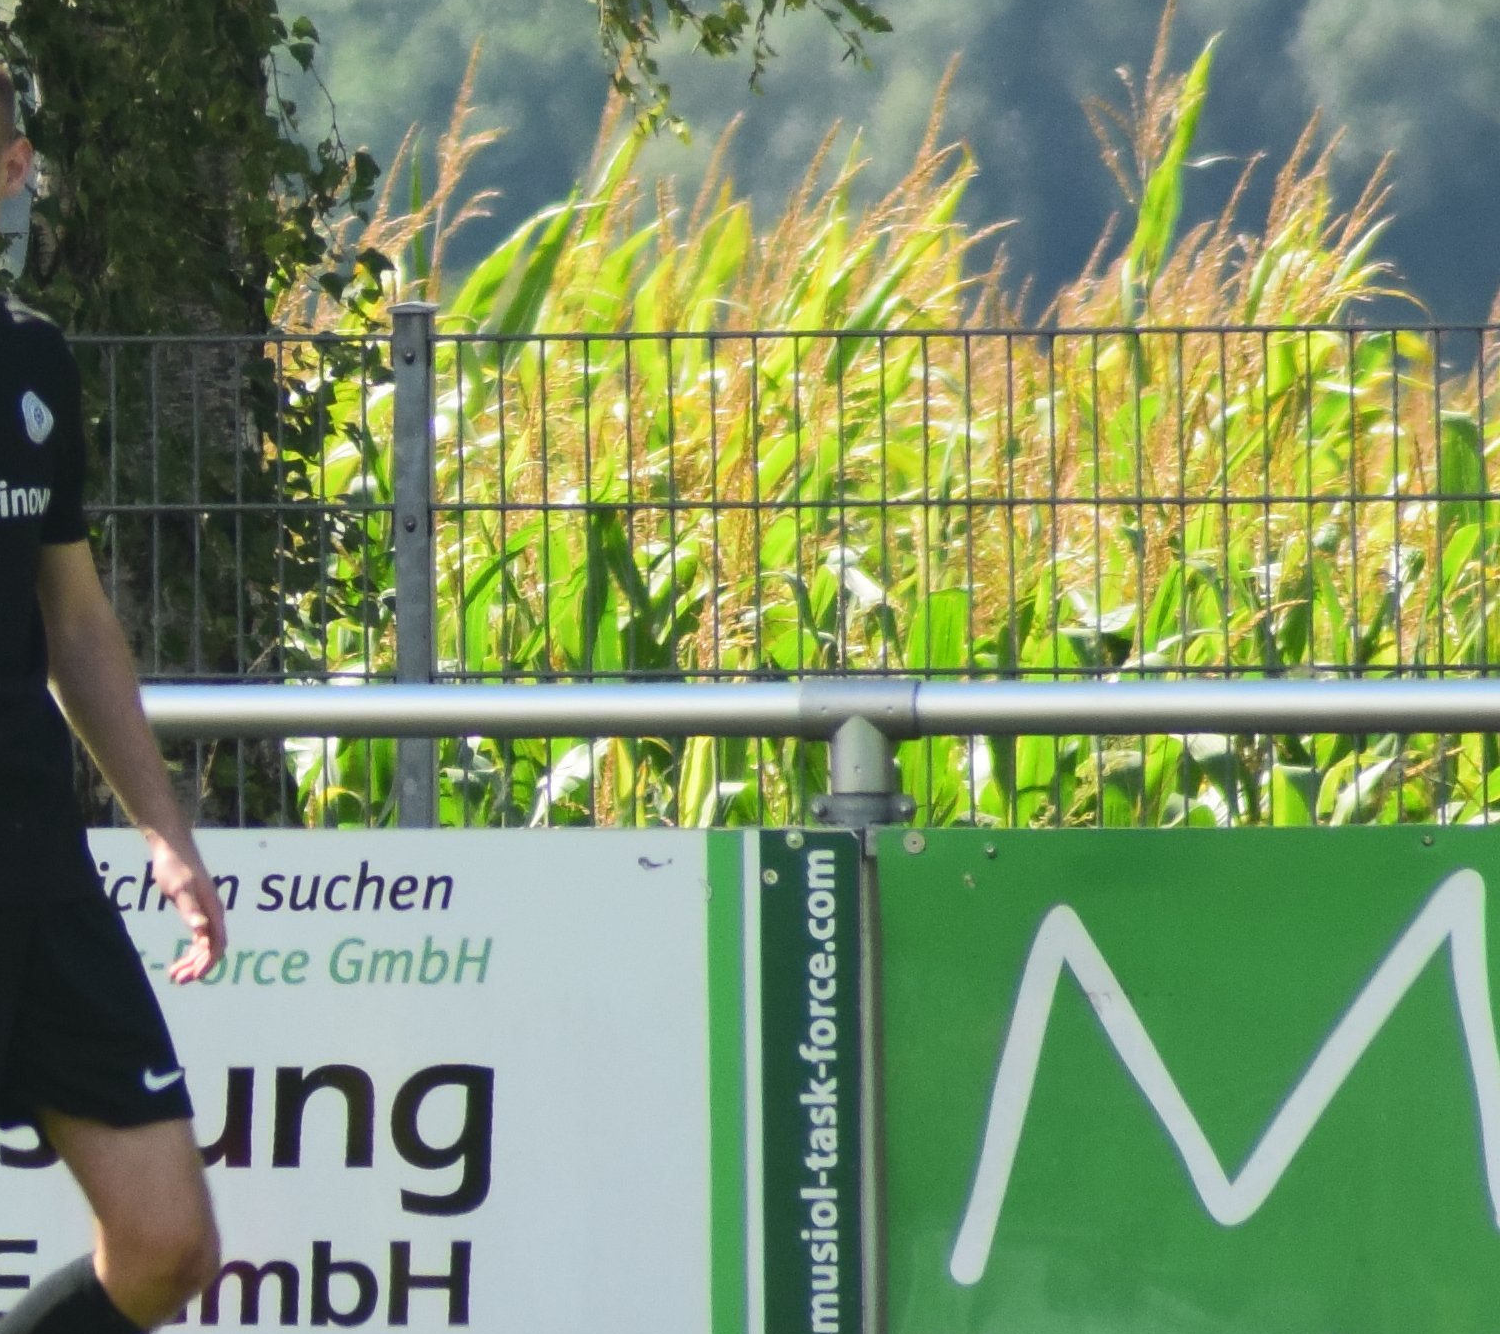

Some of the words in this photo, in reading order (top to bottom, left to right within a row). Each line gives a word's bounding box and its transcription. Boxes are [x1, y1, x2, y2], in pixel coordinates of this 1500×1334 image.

[257, 859, 454, 913] suchen
[329, 935, 493, 987] GmbH
[164, 1240, 472, 1327] mbH
